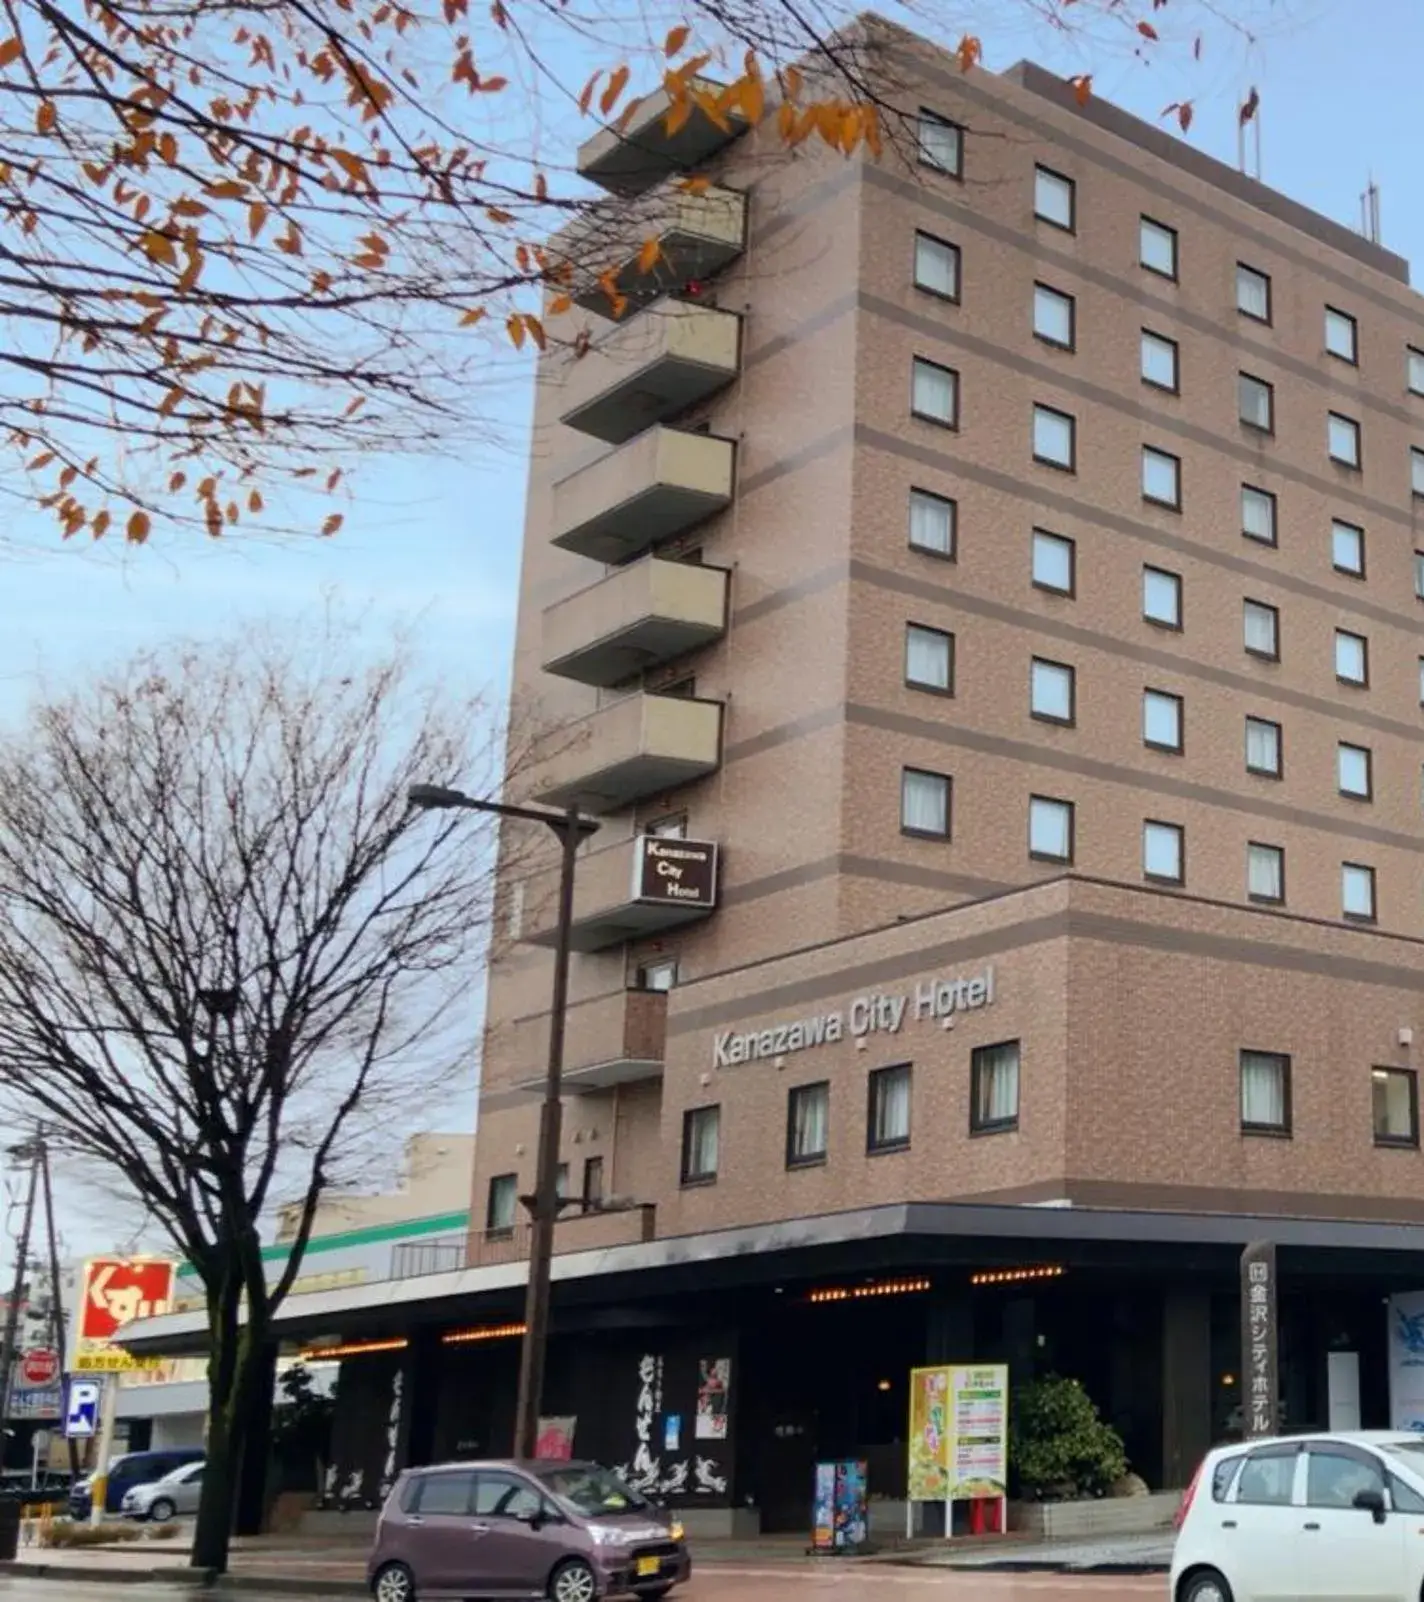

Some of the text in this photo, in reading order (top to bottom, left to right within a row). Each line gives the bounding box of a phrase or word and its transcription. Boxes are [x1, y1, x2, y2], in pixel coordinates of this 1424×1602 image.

[647, 841, 706, 860] Kanazawa
[656, 861, 683, 879] City
[667, 882, 699, 898] Hotel
[713, 965, 995, 1069] Kanazawa City Hotel
